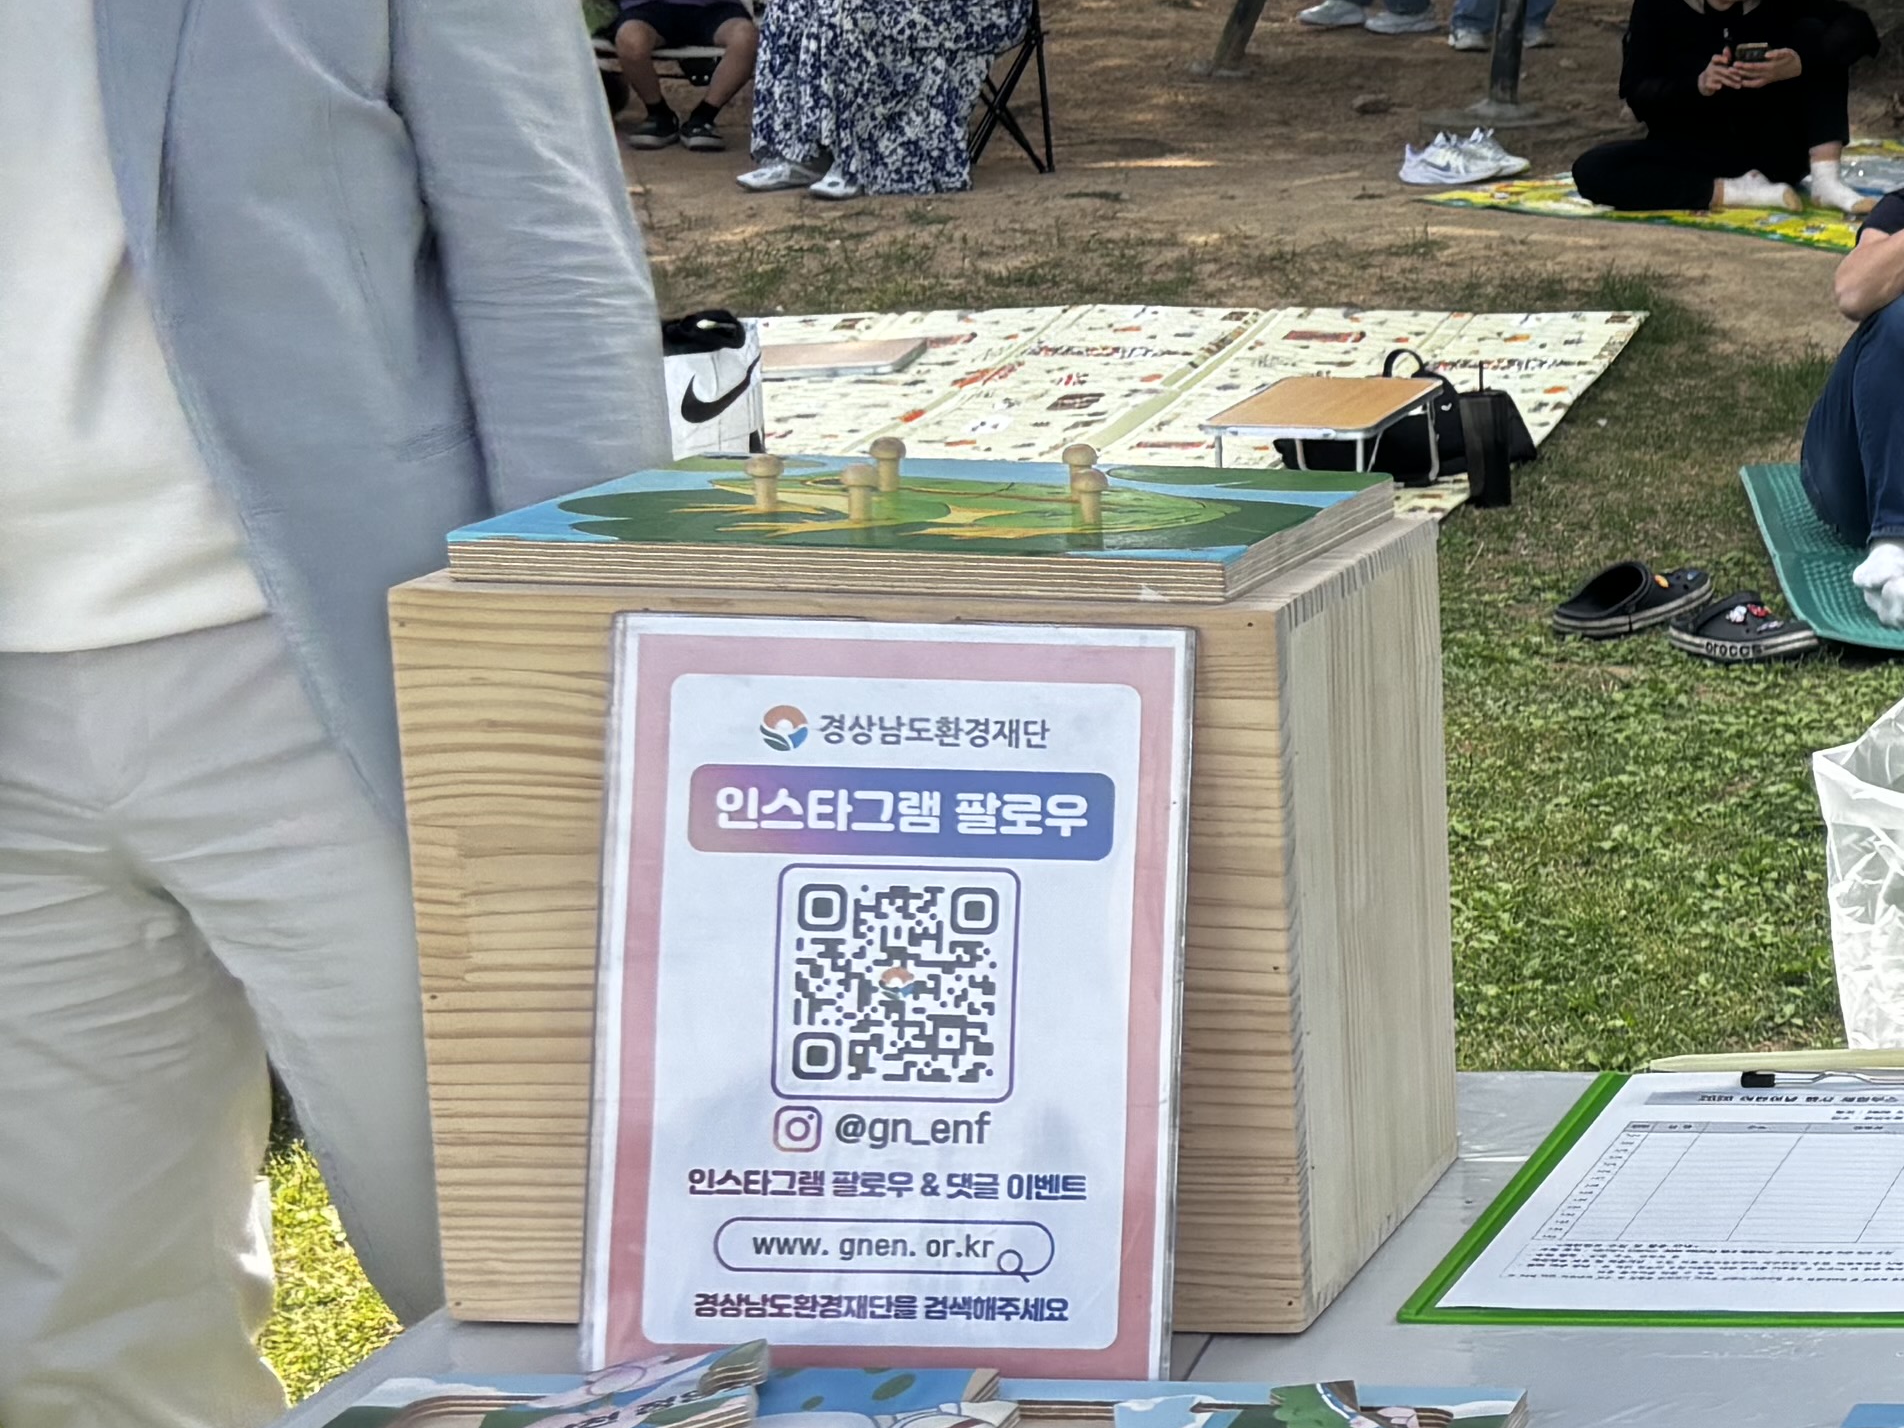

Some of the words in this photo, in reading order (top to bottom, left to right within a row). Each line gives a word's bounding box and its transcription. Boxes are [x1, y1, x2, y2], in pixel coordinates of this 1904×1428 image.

[817, 714, 1051, 750] 경상남도환경재단
[714, 789, 941, 833] 인스타그램
[954, 791, 1089, 837] 팔로우
[834, 1112, 991, 1149] @gn_enf
[688, 1169, 825, 1199] 인스타그램
[832, 1171, 913, 1199] 팔로우
[920, 1173, 941, 1198] &
[946, 1172, 1000, 1201] 댓글
[1006, 1173, 1087, 1202] 이벤트
[694, 1292, 918, 1322] 경상남도환경재단을
[924, 1295, 1069, 1324] 검색해주세요
